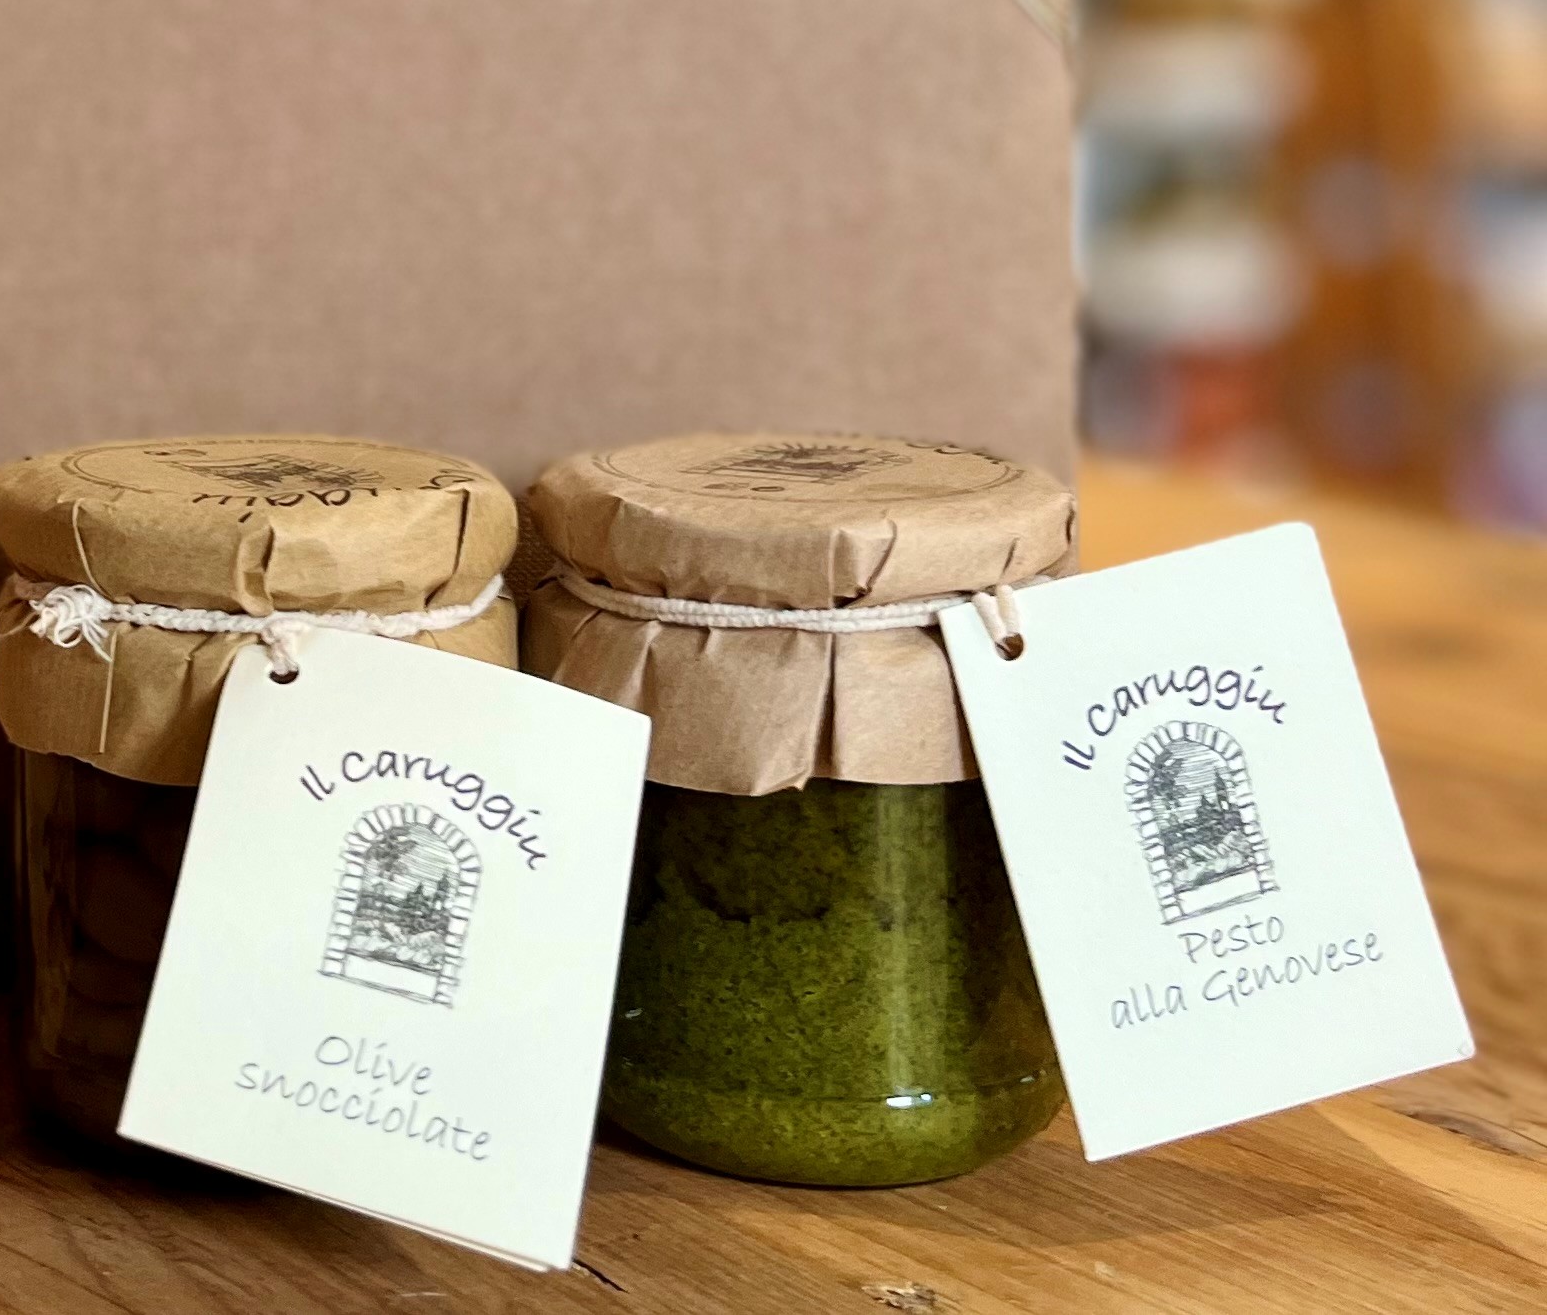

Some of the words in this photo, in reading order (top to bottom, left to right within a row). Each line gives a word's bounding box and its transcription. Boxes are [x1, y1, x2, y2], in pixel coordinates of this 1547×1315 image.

[1177, 914, 1286, 964] Pesto
[1110, 984, 1187, 1031] alla
[1202, 930, 1384, 1009] Genovese
[314, 1035, 433, 1097] Olive
[234, 1060, 494, 1163] snocciolate
